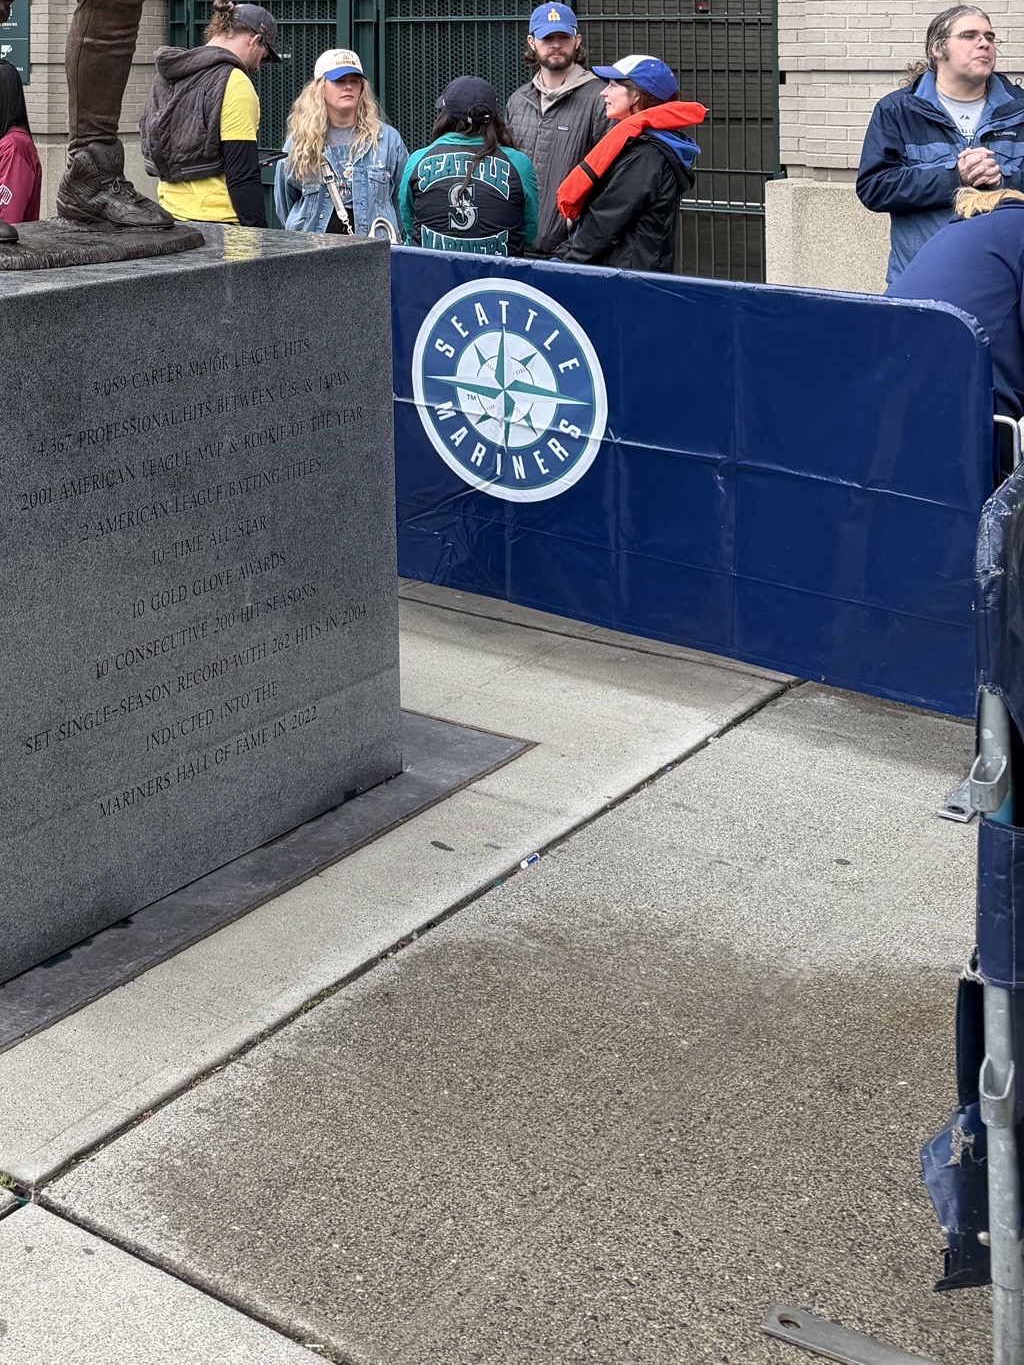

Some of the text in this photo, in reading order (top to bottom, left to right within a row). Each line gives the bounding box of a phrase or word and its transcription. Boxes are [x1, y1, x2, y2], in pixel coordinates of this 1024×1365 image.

[132, 364, 184, 389] CAREER
[189, 354, 229, 377] MAJOR
[235, 345, 279, 368] LEAGUE
[284, 338, 310, 357] HITS
[435, 299, 580, 375] SEATTLE
[78, 409, 179, 448] PROFESSIONAL
[183, 402, 213, 422] HITS
[217, 387, 274, 414] BETWEEN
[318, 369, 351, 395] JAPAN
[434, 400, 582, 480] MARINERS
[21, 406, 363, 511] 2001 AMERICAN LEAGUE MVP & ROOKIE OF THE YEAR
[78, 456, 322, 544] 2 AMERICAN LEAGUE BATTING TITLES
[152, 515, 267, 566] 10-TIME ALL-STAR
[132, 550, 287, 619] 10 GOLD GLOVE AWARDS
[95, 581, 317, 680] 10 CONSECUTIVE 200 HIT SEASONS
[24, 604, 367, 756] SET SINGLE-SEASON RECORD WITH 262 HITS IN 2004
[145, 680, 277, 752] INDUCTED INTO THE
[99, 705, 318, 818] MARINERS HALL OF FAME IN 2022
